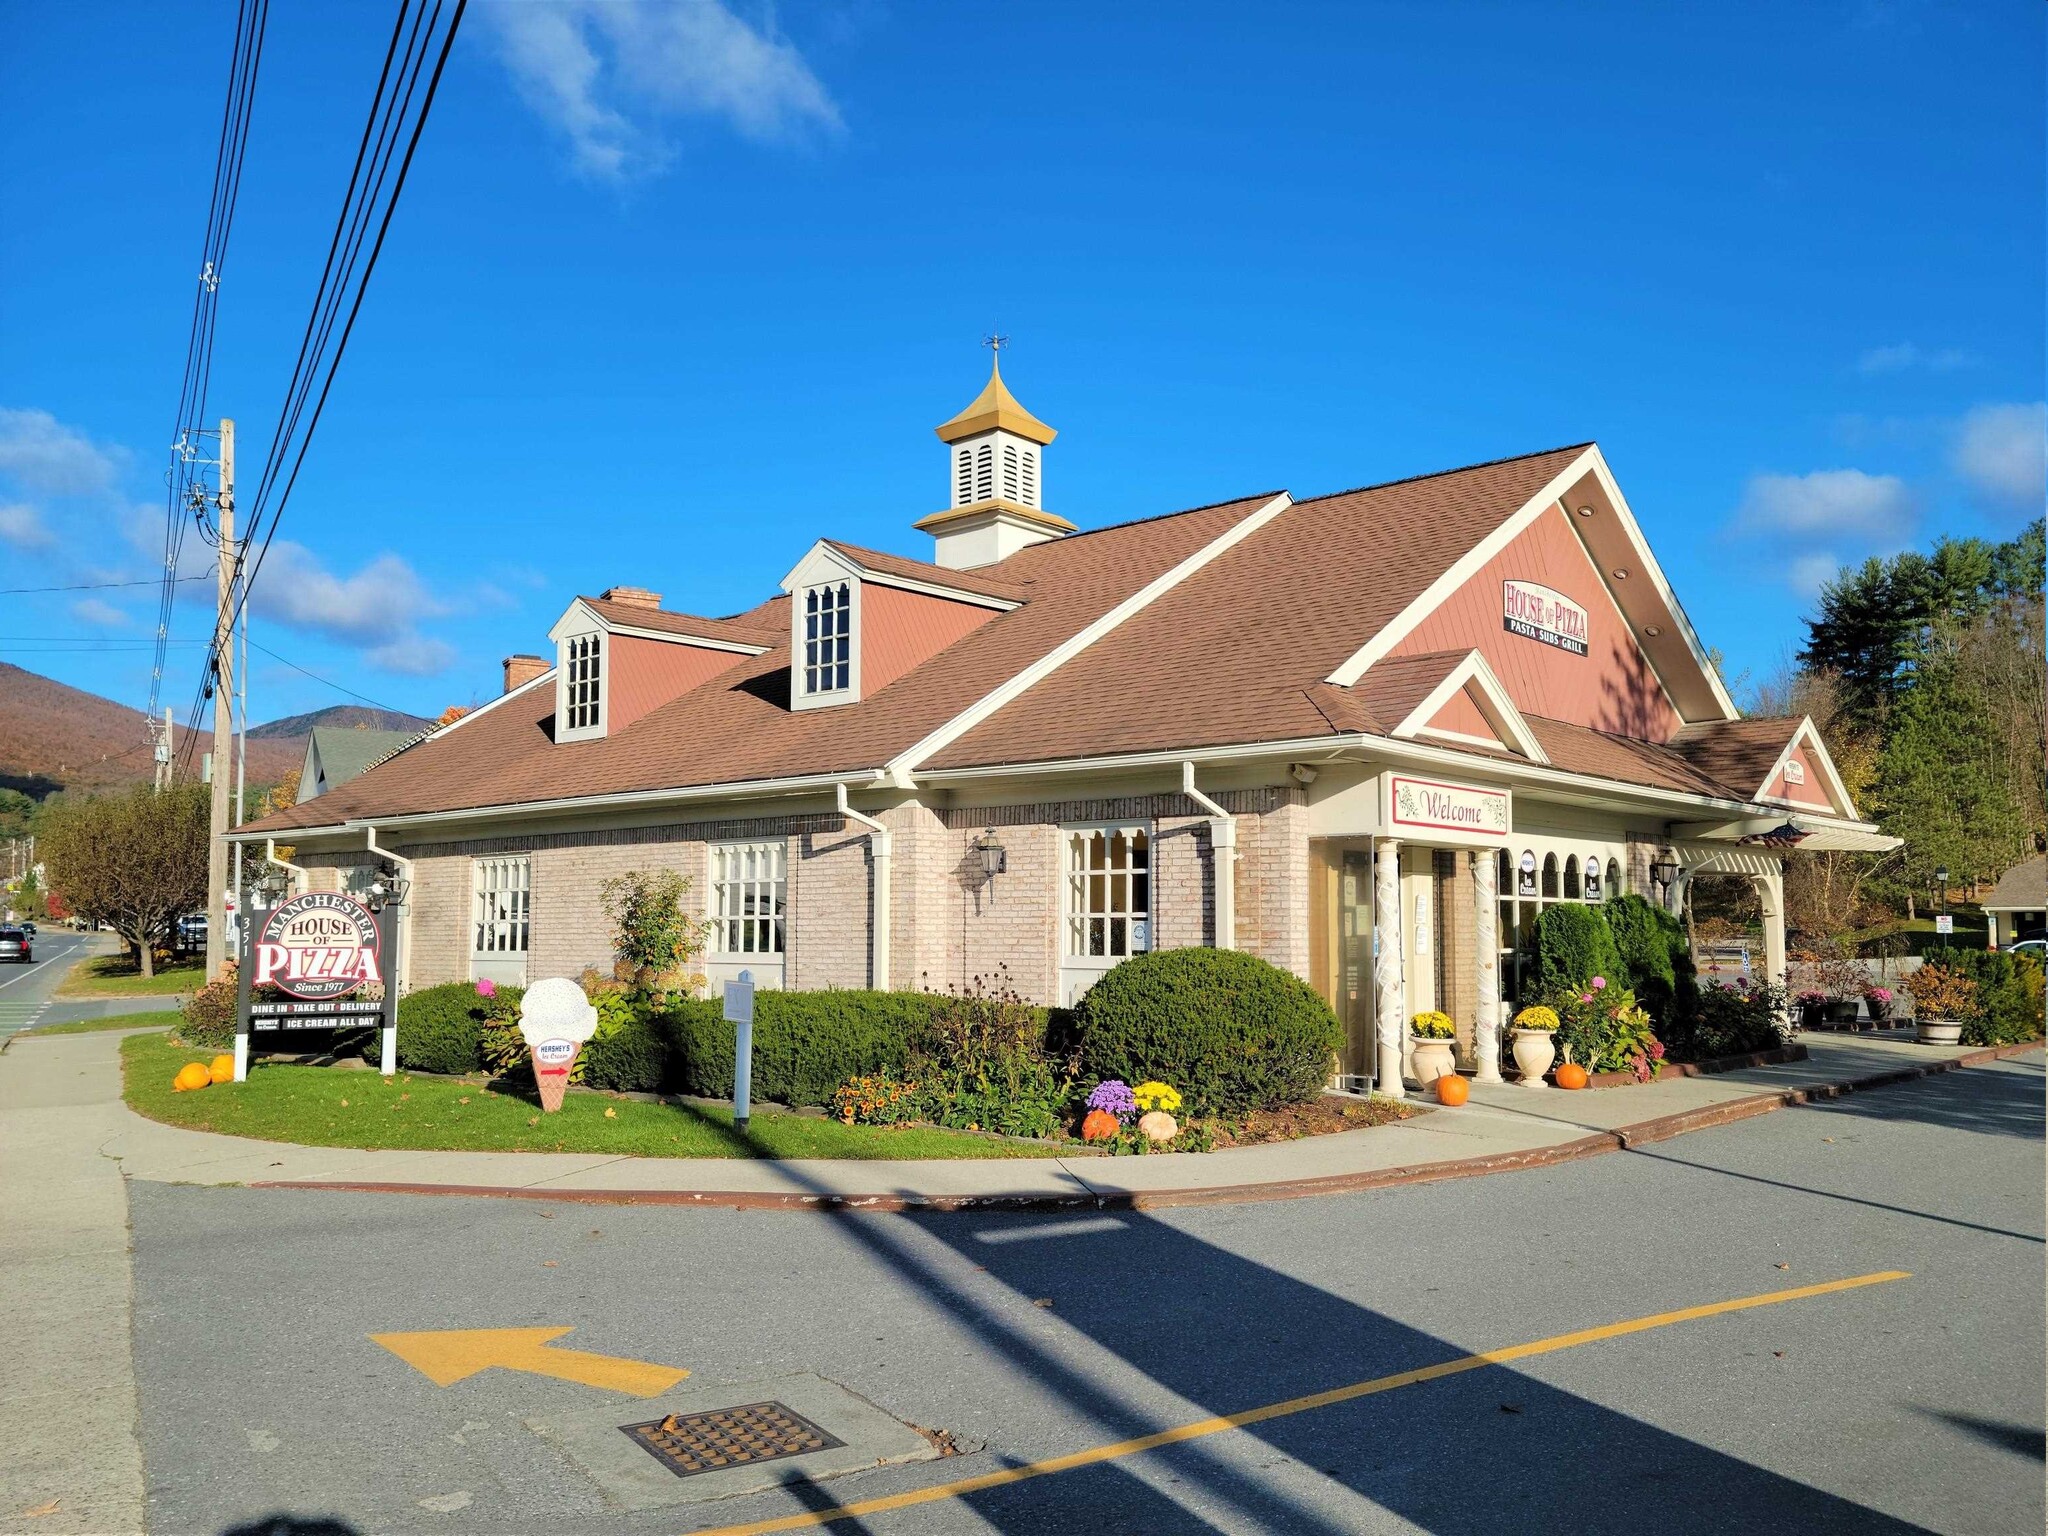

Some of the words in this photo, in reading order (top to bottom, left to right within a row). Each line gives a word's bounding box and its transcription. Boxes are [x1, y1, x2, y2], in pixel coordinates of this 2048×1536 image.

[1506, 584, 1544, 624] HOUSE
[1555, 601, 1586, 640] PIZZA
[1511, 620, 1536, 637] PASTA
[1539, 629, 1559, 645] SUBS
[1562, 638, 1583, 653] GRILL
[1420, 790, 1482, 823] Welcome
[266, 895, 375, 942] MANCHESTER
[291, 918, 353, 936] HOUSE
[313, 937, 331, 945] OF
[254, 944, 381, 984] PIZZA
[294, 982, 323, 992] Since
[324, 982, 344, 991] 1977
[252, 1005, 274, 1013] DINE
[277, 1004, 288, 1012] IN
[293, 1004, 315, 1012] TAKE
[318, 1003, 335, 1011] OUT
[340, 1002, 381, 1011] DELIVERY
[287, 1020, 302, 1028] ICE
[305, 1019, 337, 1027] CREAM
[340, 1018, 356, 1026] ALL
[358, 1017, 375, 1026] DAY
